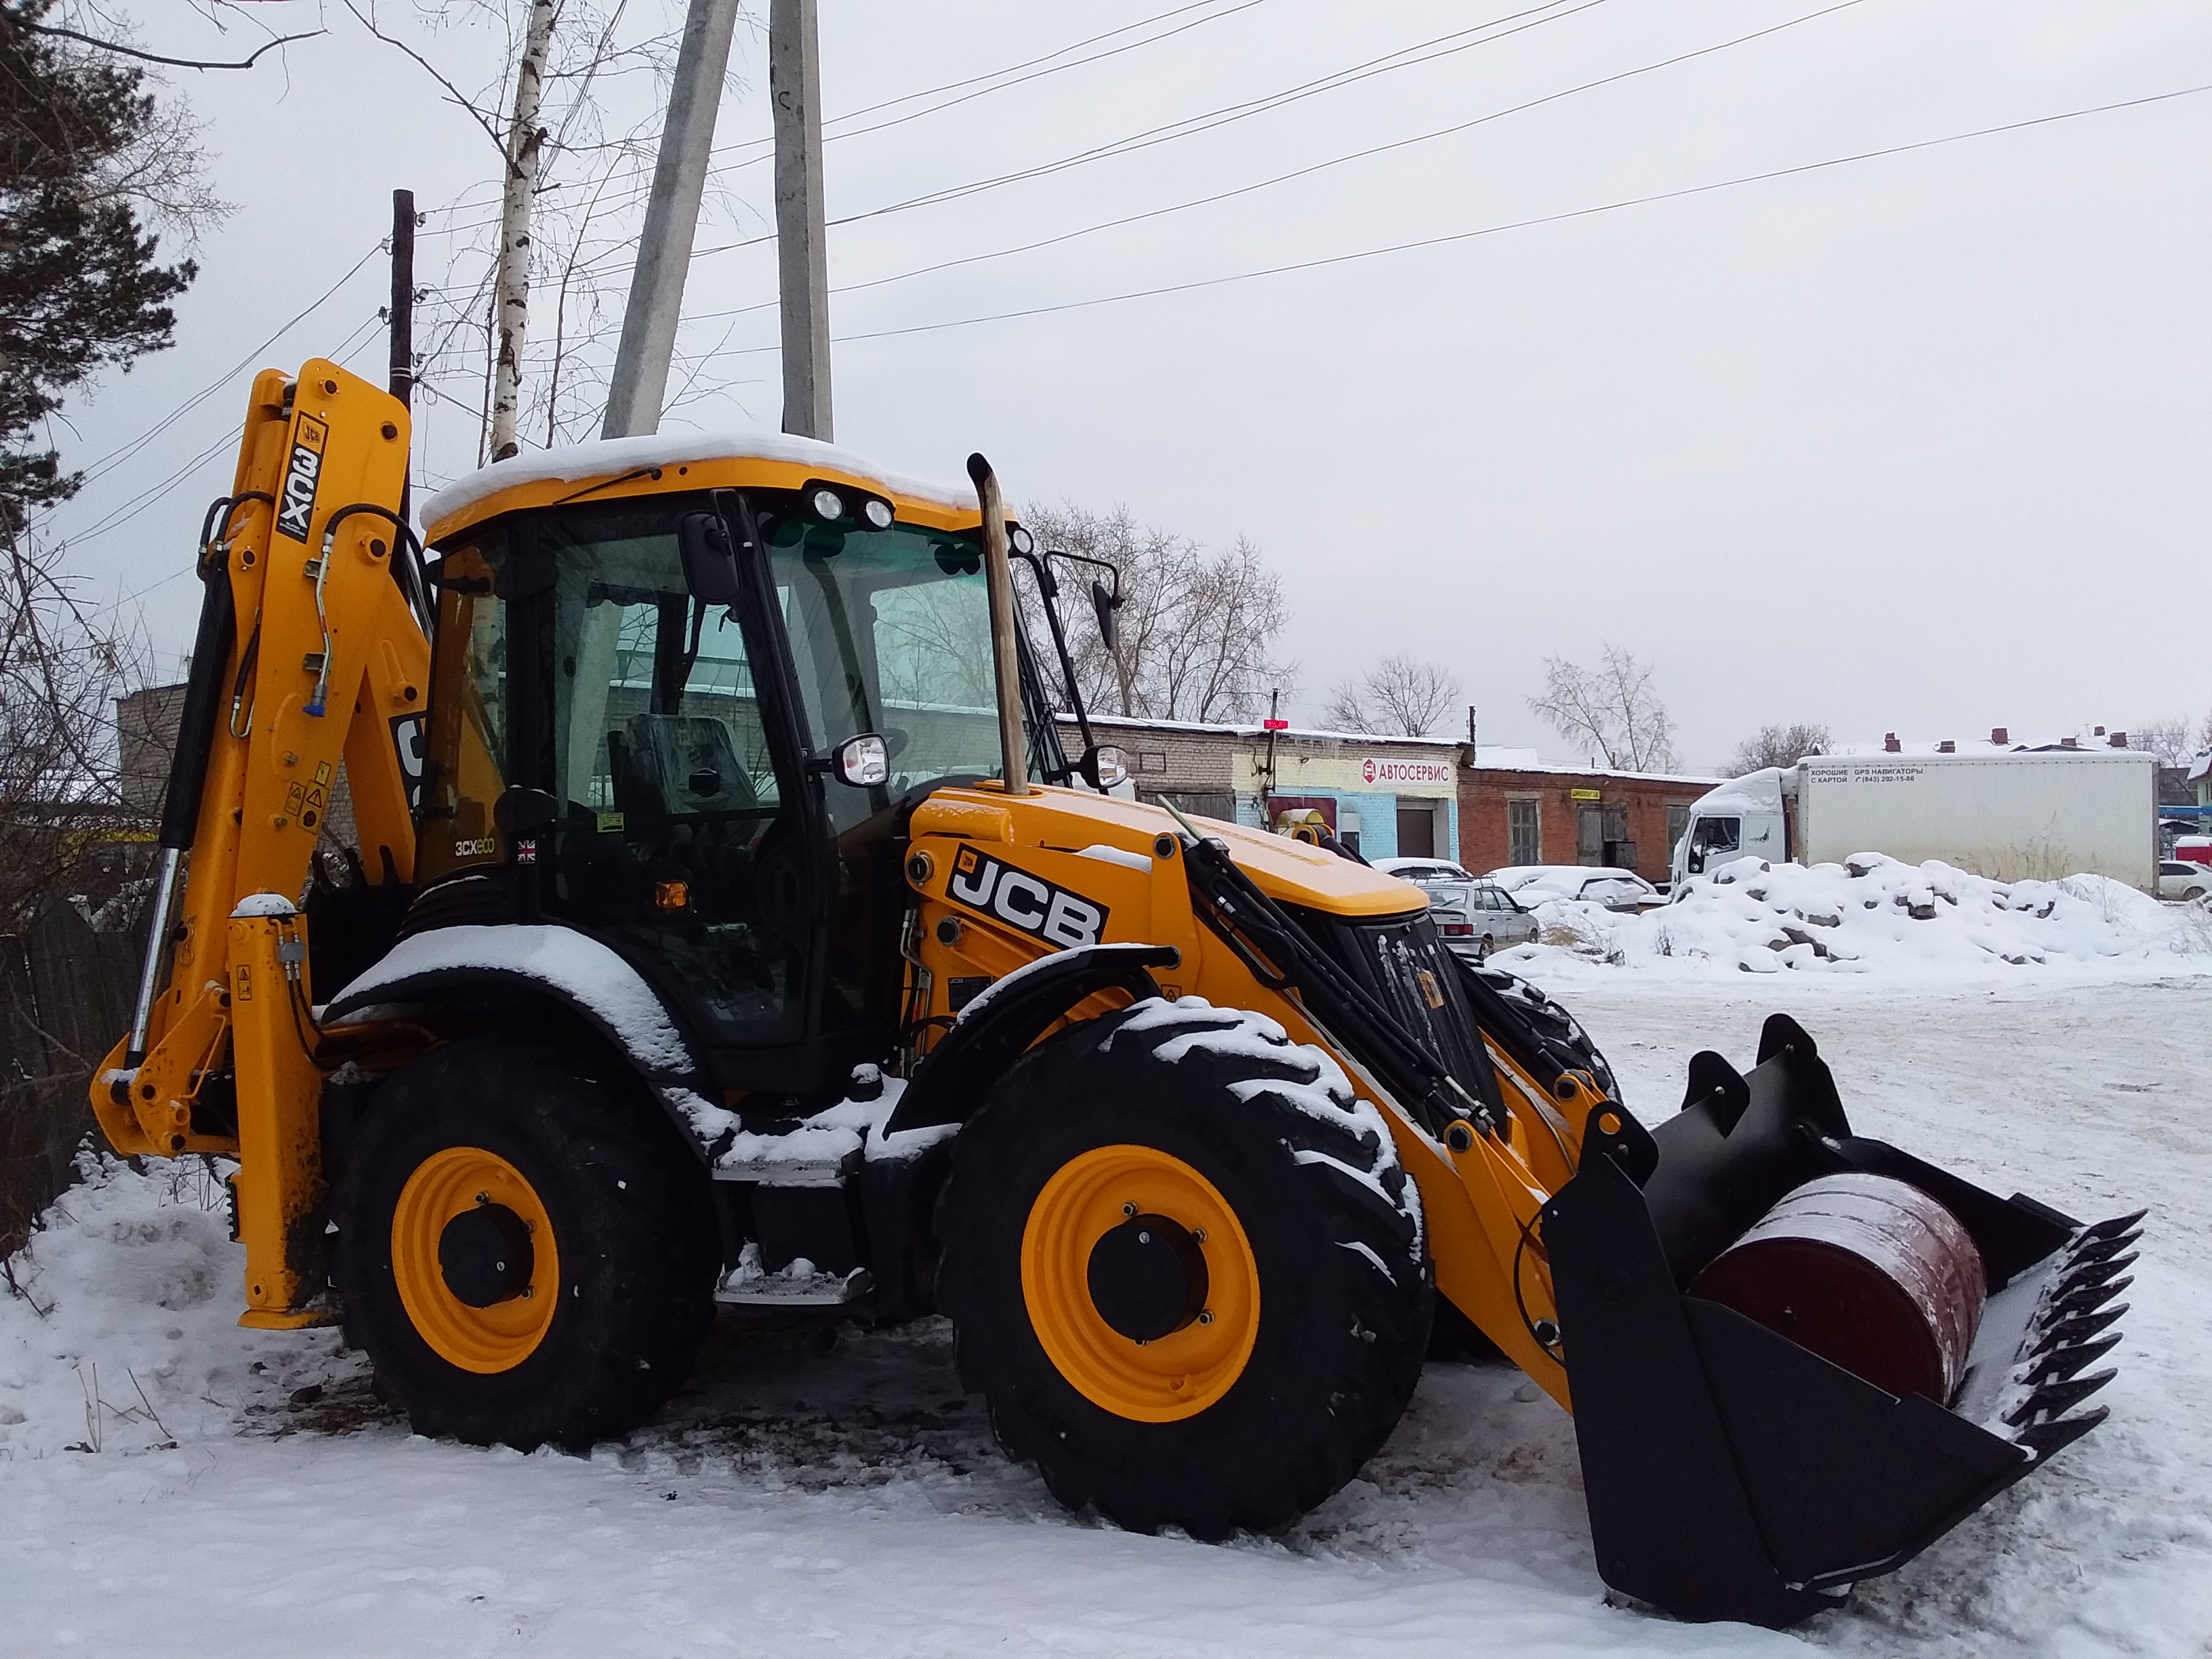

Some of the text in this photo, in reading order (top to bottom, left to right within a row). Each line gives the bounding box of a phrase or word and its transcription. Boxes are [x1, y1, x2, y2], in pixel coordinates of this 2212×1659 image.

[304, 425, 319, 442] JCB
[279, 447, 319, 529] 3CX
[1378, 764, 1449, 781] АВТОСЕРВИС
[952, 860, 1101, 949] JCB
